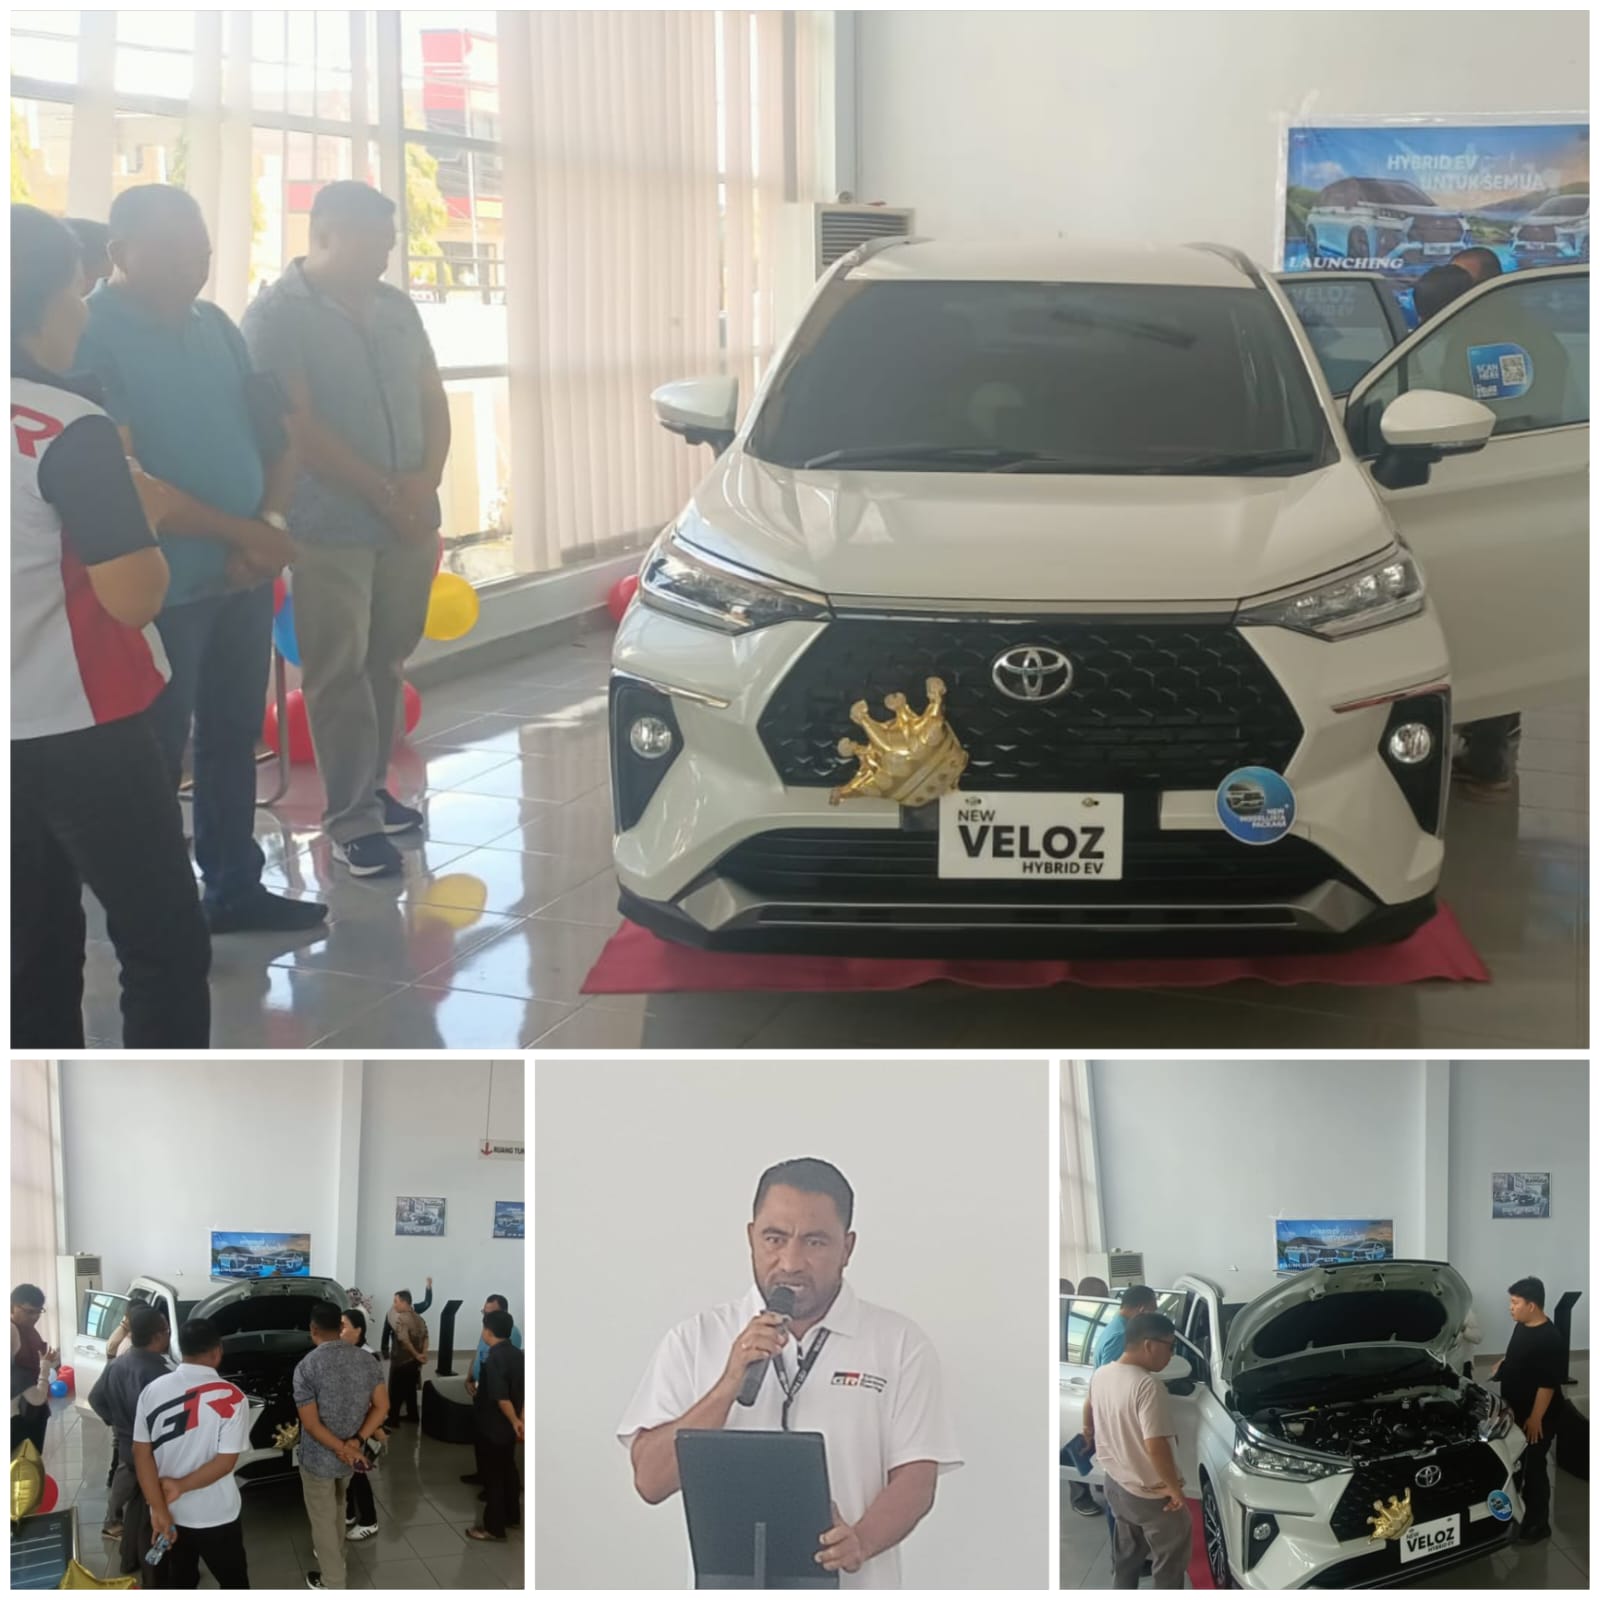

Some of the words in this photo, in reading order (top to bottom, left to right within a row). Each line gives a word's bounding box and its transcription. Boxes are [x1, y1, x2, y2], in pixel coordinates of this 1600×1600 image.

[1387, 154, 1449, 170] HYBRID
[1453, 154, 1478, 170] EV
[1421, 174, 1480, 191] UNTUK
[1482, 172, 1545, 191] SEMUA
[1289, 257, 1404, 269] LAUNCHING
[958, 810, 995, 822] NEW
[958, 826, 1105, 859] VELOZ
[1022, 862, 1080, 875] HYBRID
[1084, 863, 1104, 875] EV
[146, 1382, 245, 1450] GR
[1406, 1527, 1454, 1552] VELOZ
